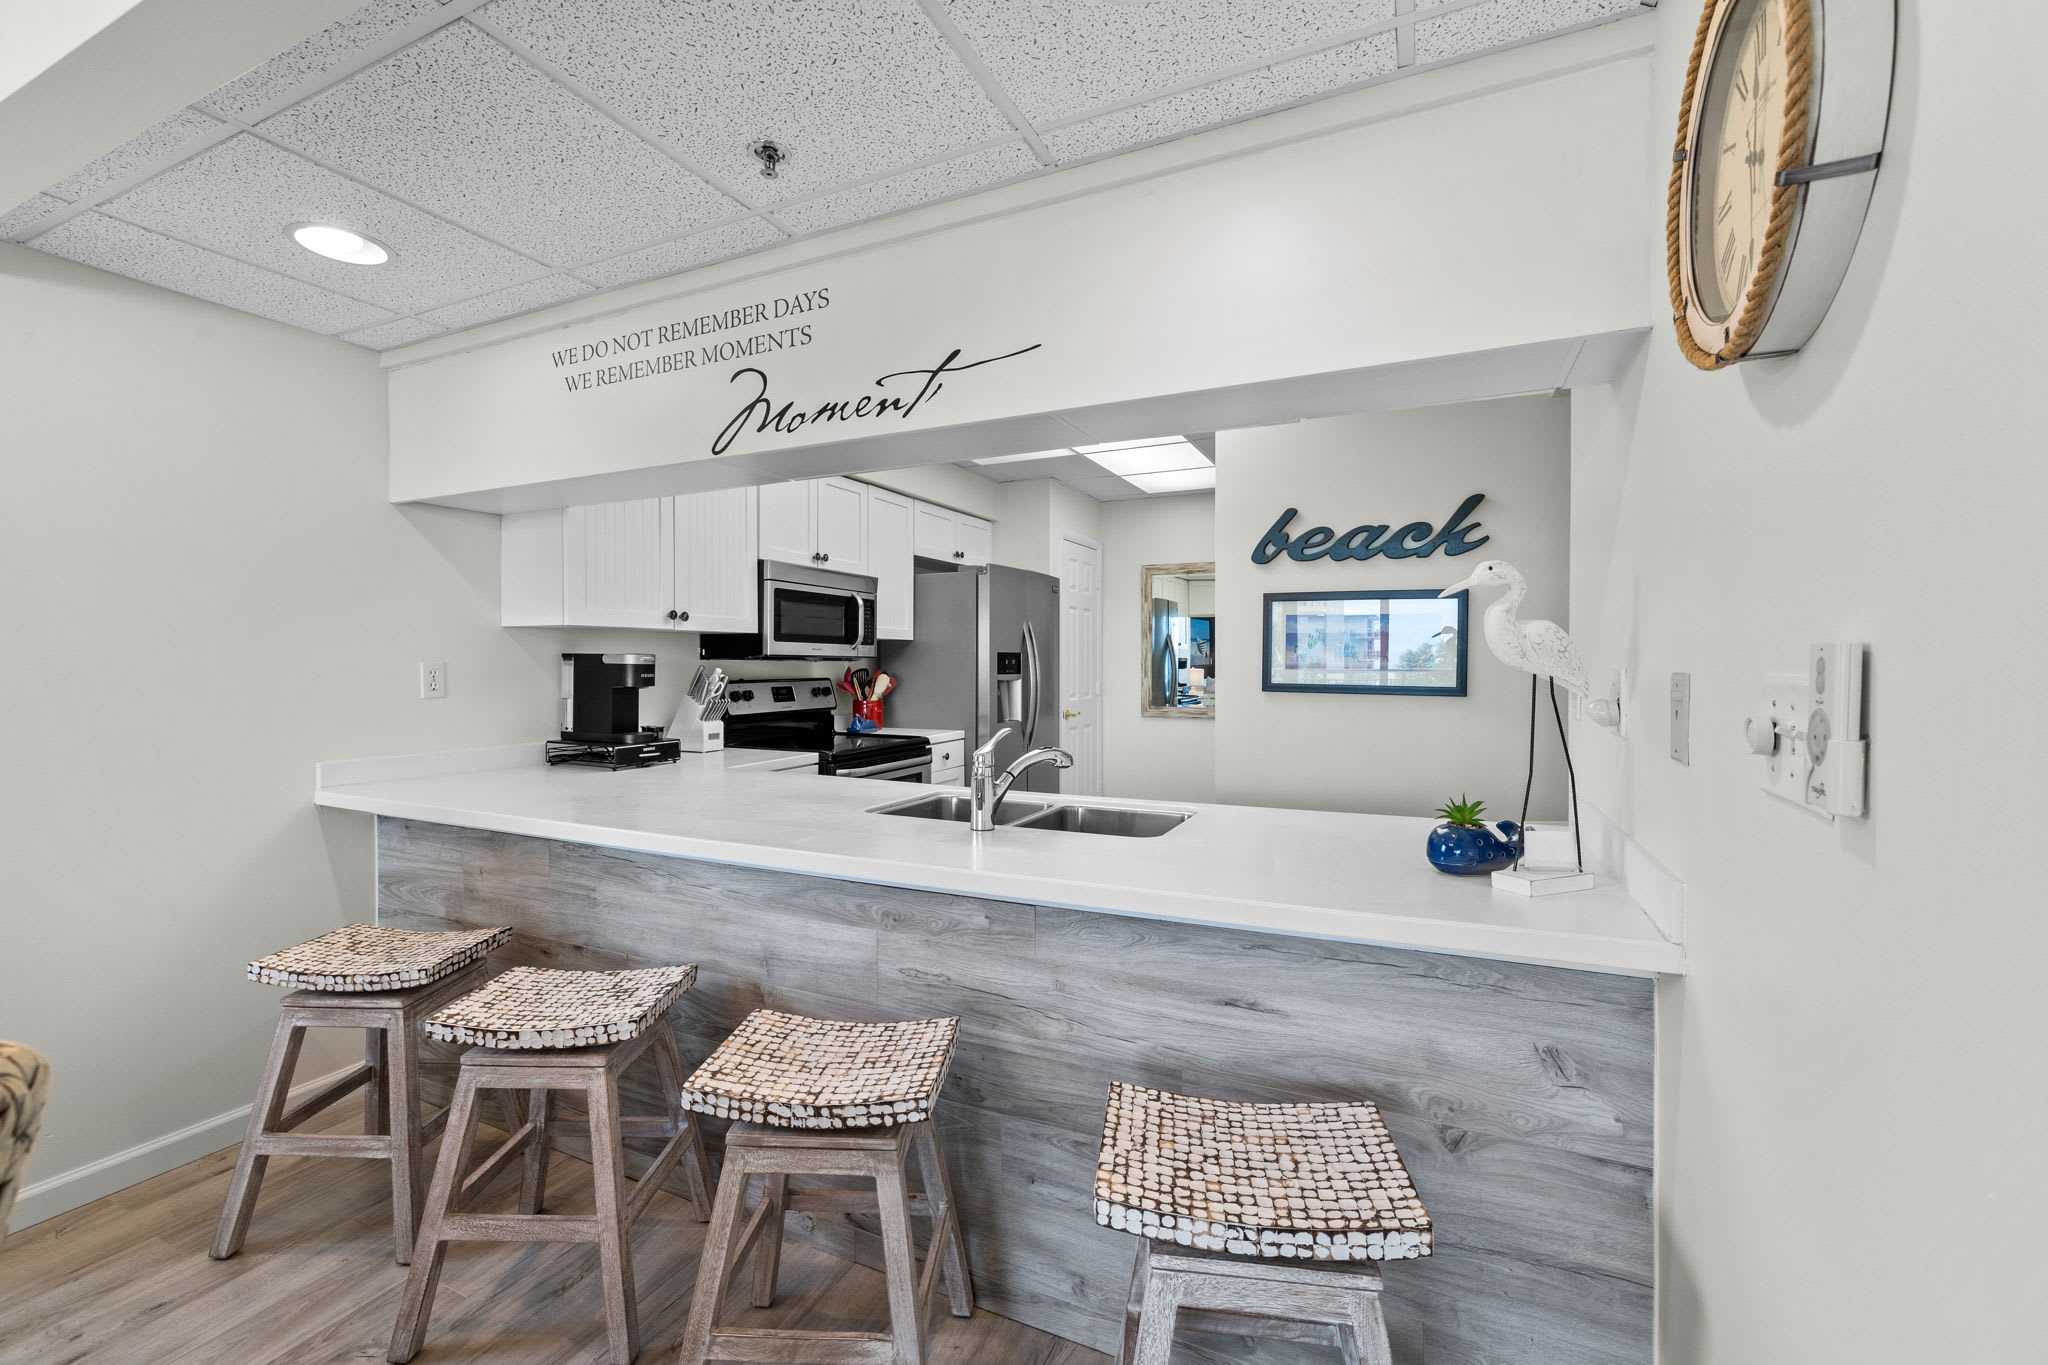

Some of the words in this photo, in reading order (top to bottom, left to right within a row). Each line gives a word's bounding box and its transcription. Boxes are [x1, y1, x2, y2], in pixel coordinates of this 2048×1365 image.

[552, 346, 579, 369] WE
[581, 340, 609, 362] DO
[612, 328, 654, 355] NOT
[657, 303, 770, 345] REMEMBER
[773, 287, 830, 319] DAYS
[564, 371, 593, 393] WE
[595, 350, 698, 387] REMEMBER
[701, 324, 812, 366] MOMENTS
